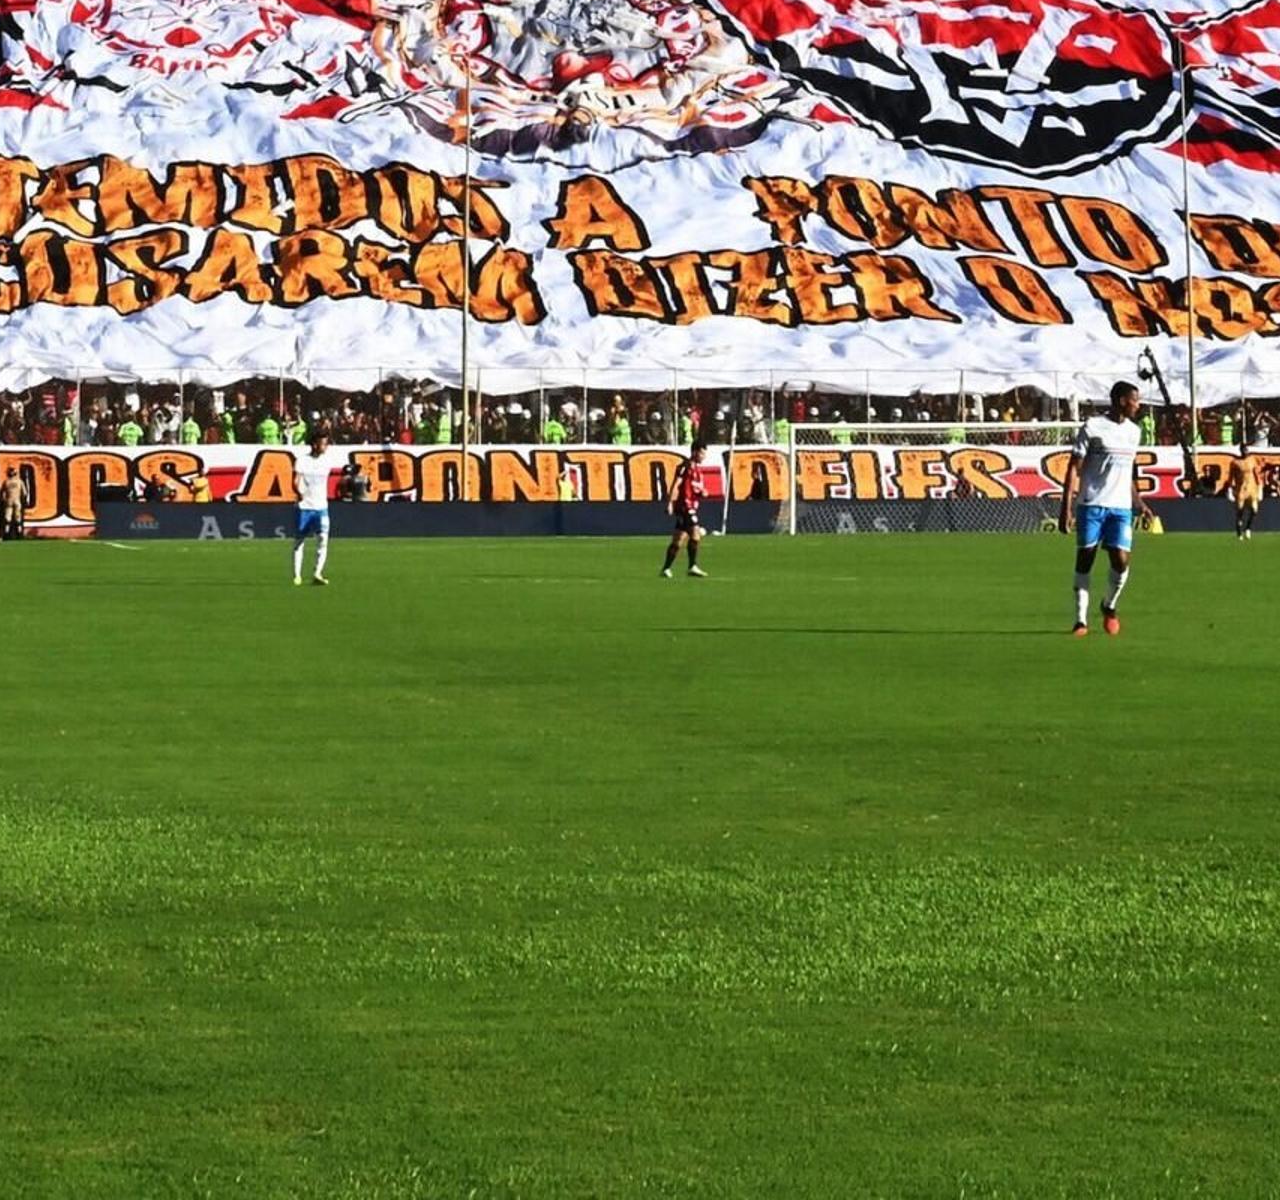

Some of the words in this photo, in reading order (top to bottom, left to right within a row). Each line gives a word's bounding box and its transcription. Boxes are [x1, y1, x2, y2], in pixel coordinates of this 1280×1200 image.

[542, 174, 652, 253] A
[741, 174, 1169, 274] PONTO
[566, 246, 962, 328] DIZER
[955, 255, 1074, 325] O
[228, 449, 300, 503] A
[348, 449, 687, 502] PONTO
